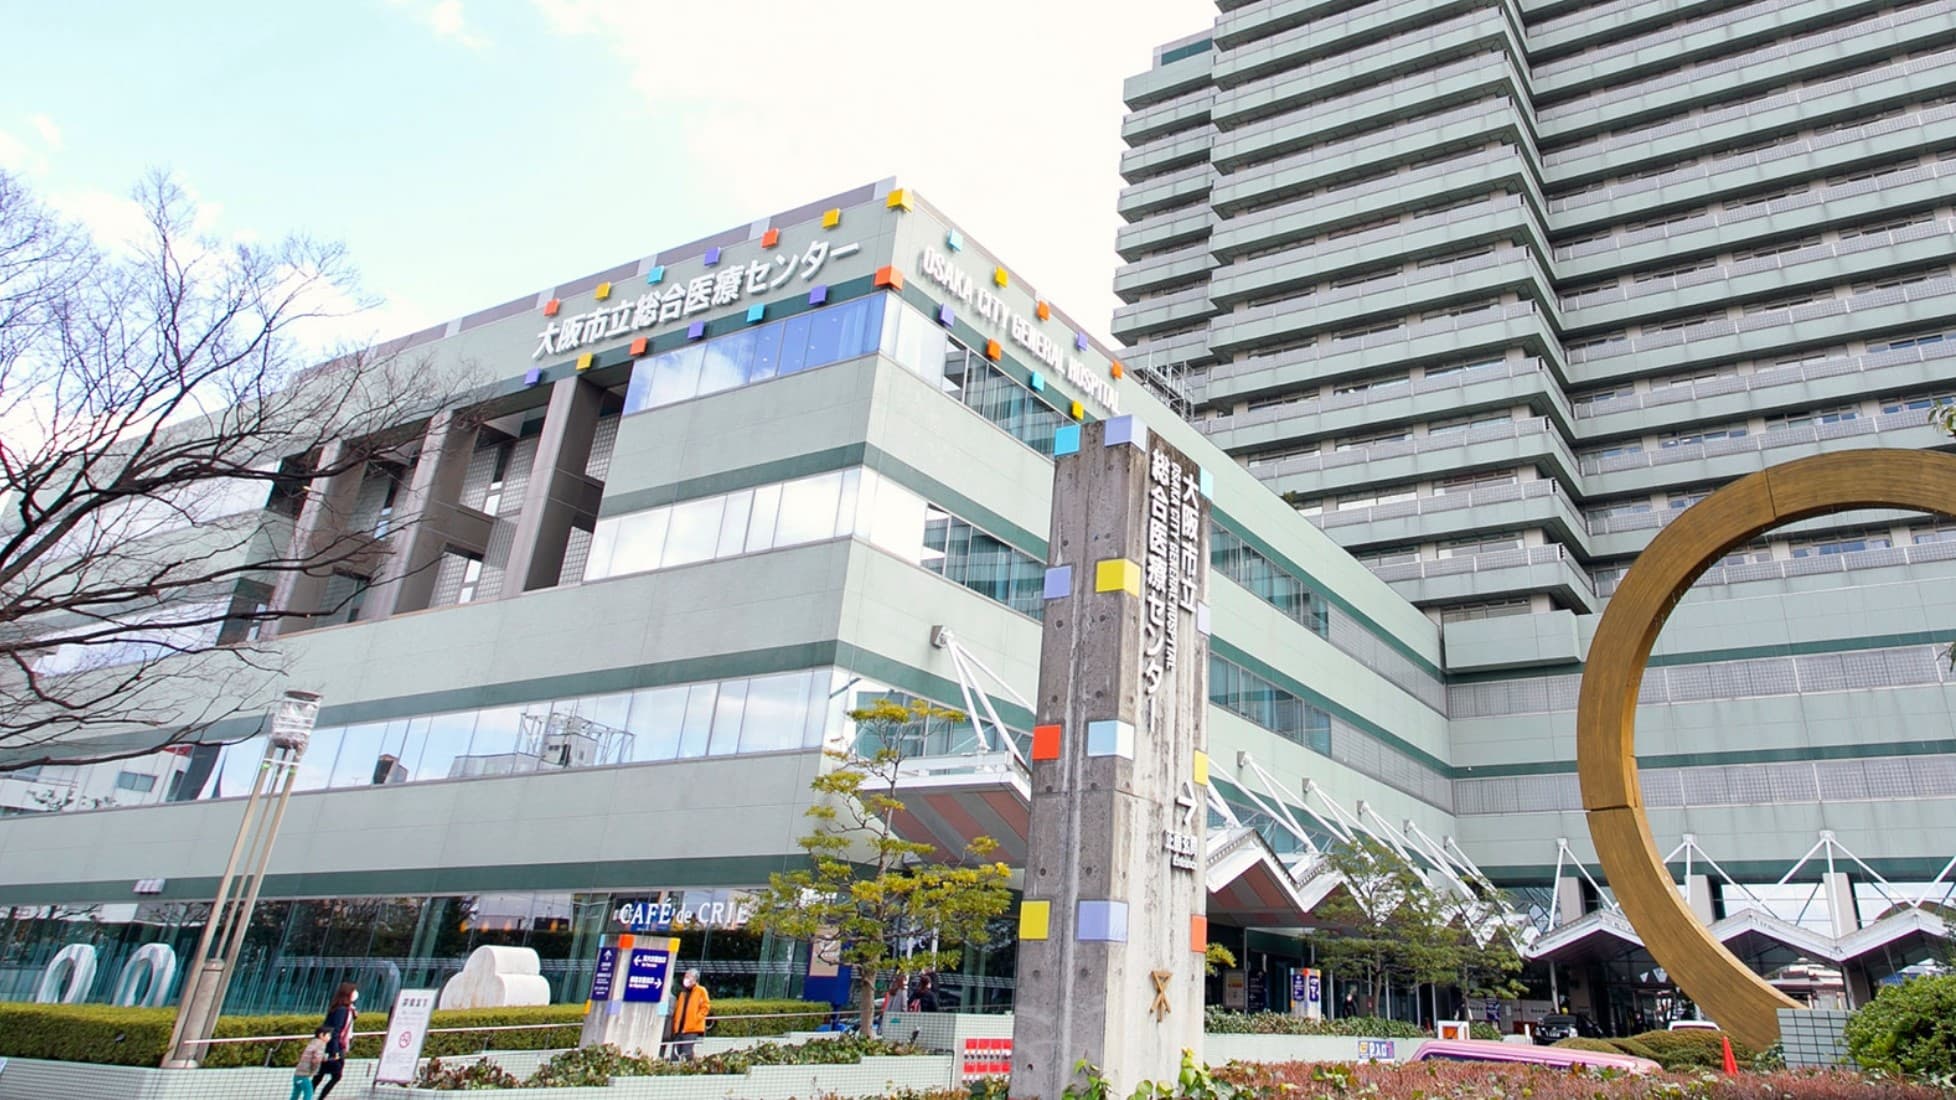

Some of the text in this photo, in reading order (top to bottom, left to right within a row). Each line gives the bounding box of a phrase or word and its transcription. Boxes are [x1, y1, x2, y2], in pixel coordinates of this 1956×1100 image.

[532, 240, 860, 359] 大阪市立総合医療センター
[922, 248, 1121, 414] OSAKA CITY GENERAL HOSPITAL
[1146, 448, 1170, 733] 総合医療センター
[1166, 461, 1182, 672] OSAKA CITY GENERAL HOSPITAL
[1181, 473, 1200, 613] 大阪市立
[619, 898, 672, 925] CAFÉ
[676, 903, 692, 924] de
